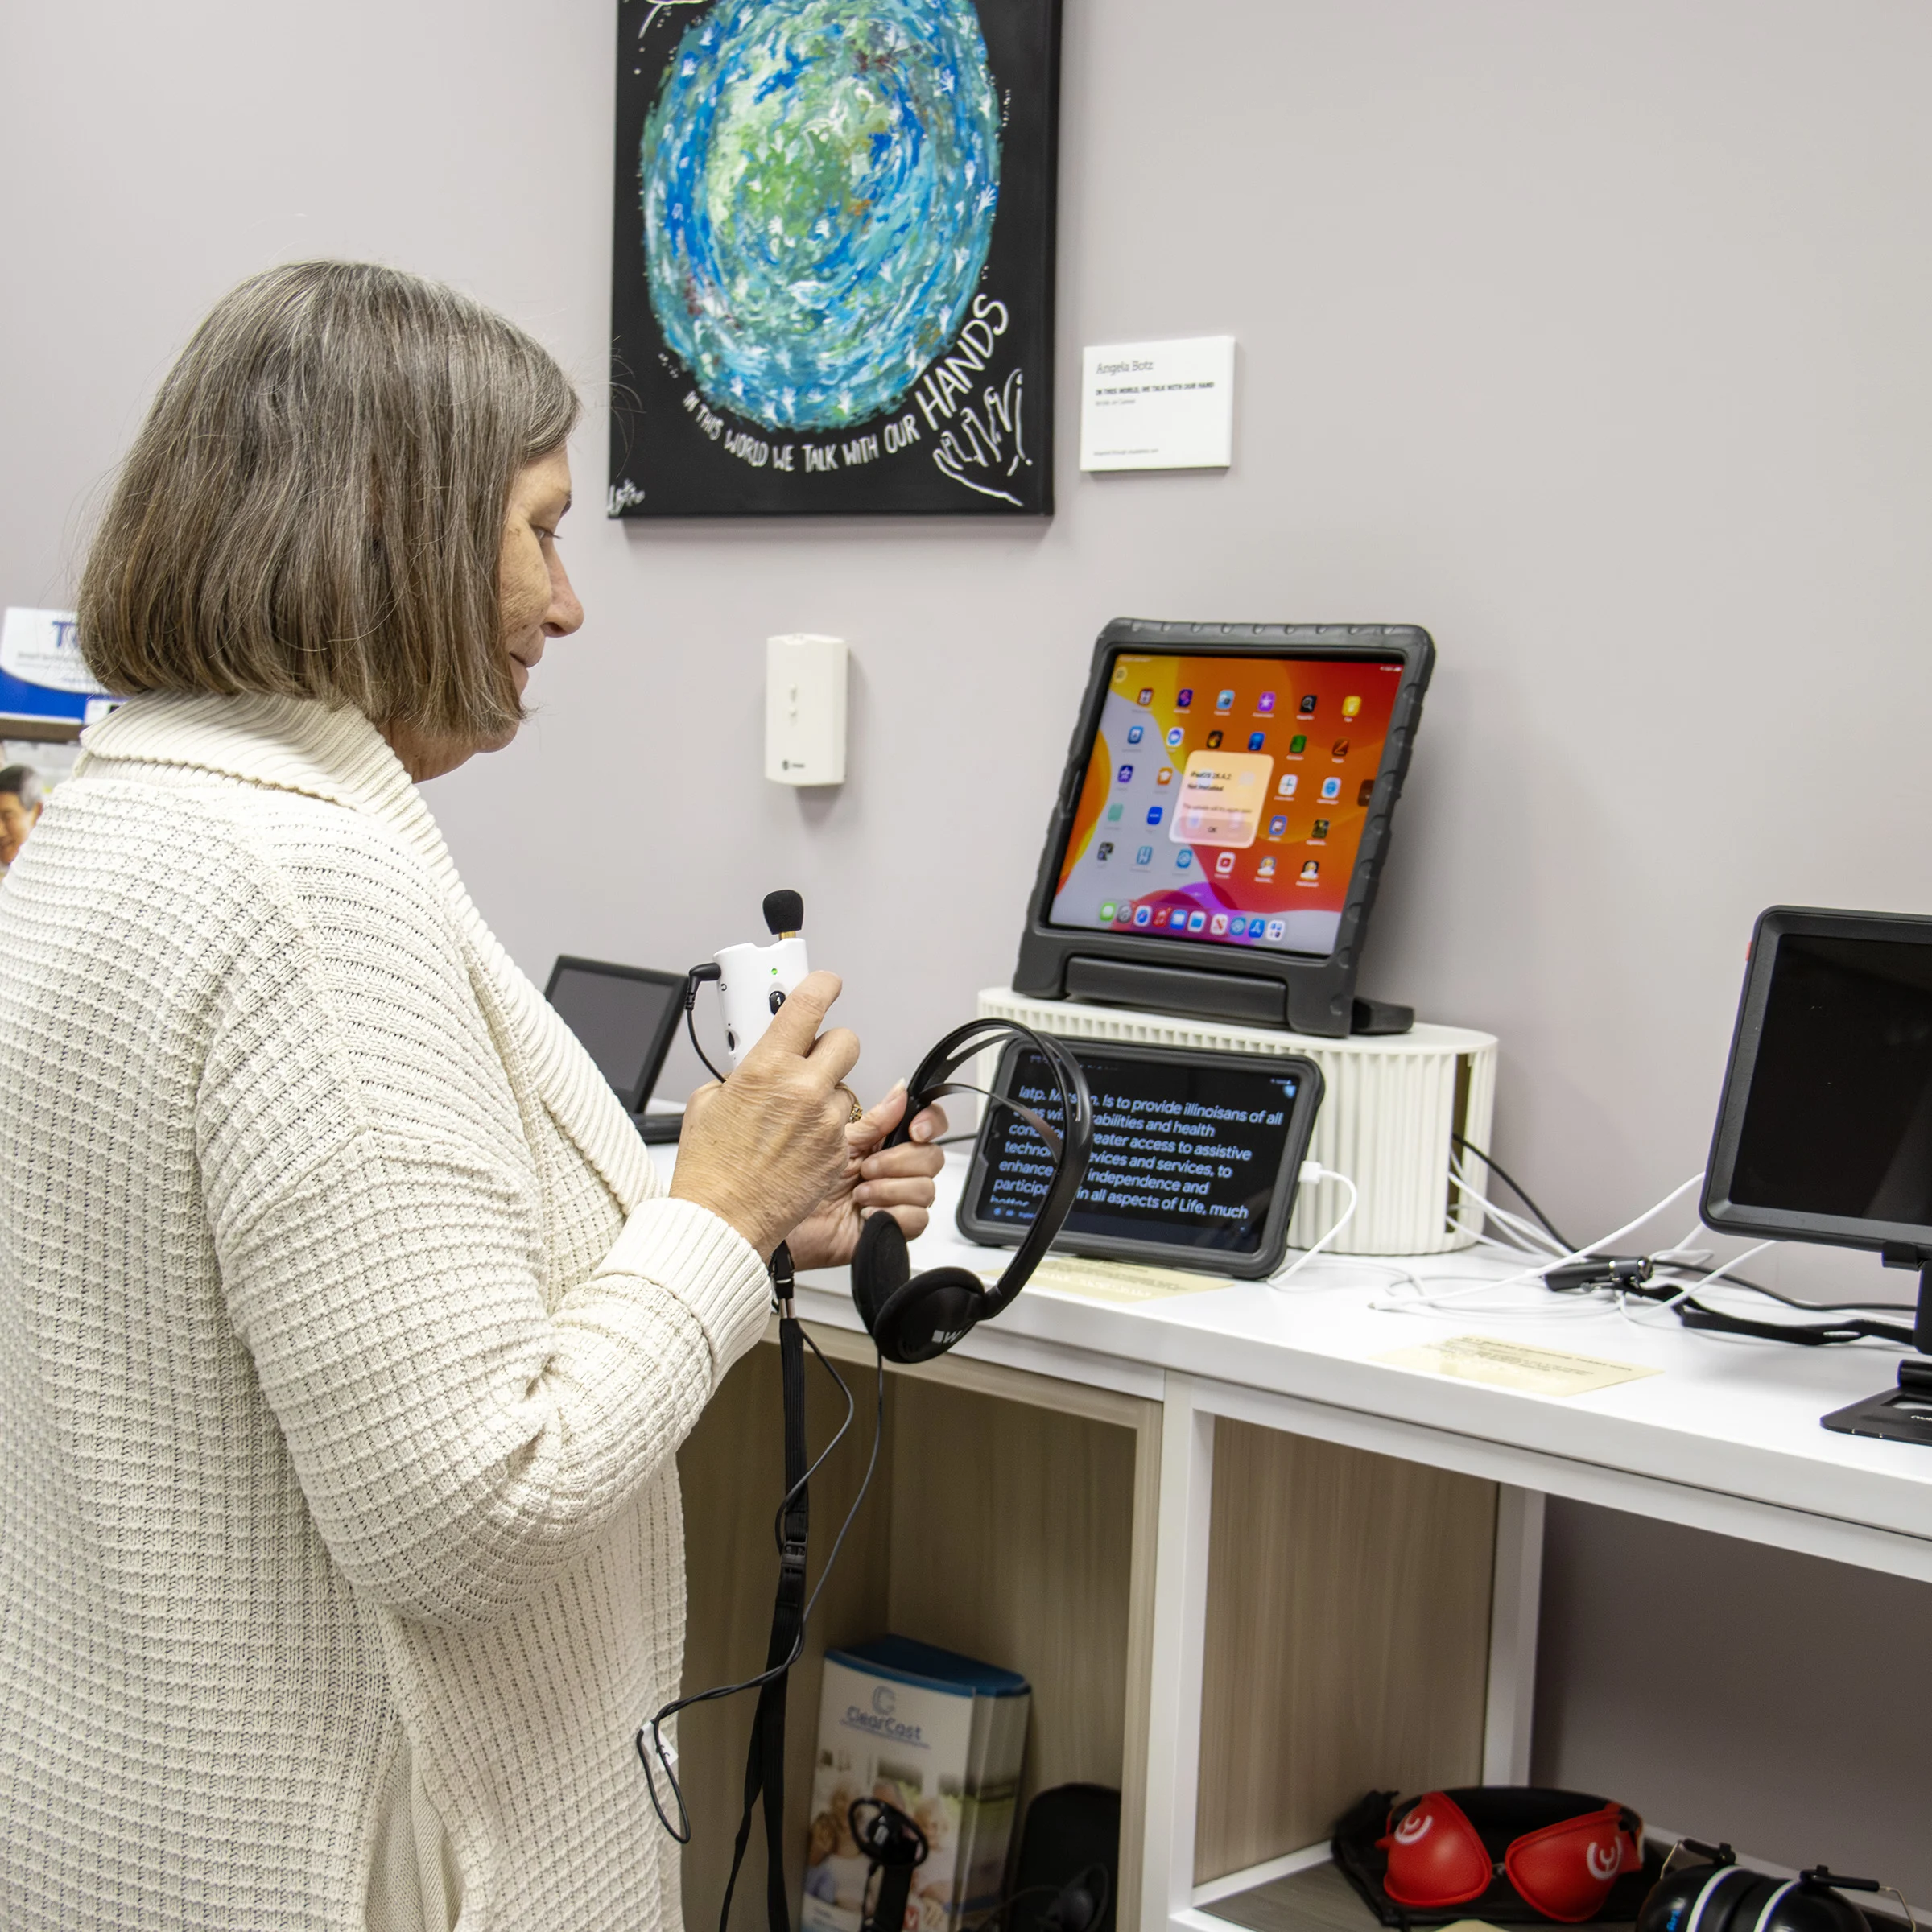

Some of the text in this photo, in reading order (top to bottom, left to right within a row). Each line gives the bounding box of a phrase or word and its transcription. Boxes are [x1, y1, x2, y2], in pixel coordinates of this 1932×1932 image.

[696, 403, 724, 440] THIS
[724, 429, 769, 467] WORLD
[772, 444, 795, 472] WE
[801, 444, 839, 473] TALK
[841, 434, 879, 466] WITH
[884, 414, 921, 453] OUR
[914, 293, 1009, 431] HANDS
[1096, 361, 1153, 376] Angela Botz
[1117, 1096, 1131, 1109] to
[1131, 1100, 1183, 1115] provide
[1249, 1110, 1267, 1124] of
[1266, 1111, 1284, 1125] all
[1146, 1119, 1173, 1133] and
[1173, 1120, 1216, 1137] health
[1130, 1137, 1176, 1152] access
[1178, 1141, 1193, 1154] to
[1194, 1144, 1253, 1161] assistive
[999, 1159, 1211, 1195] enhance independence and
[1089, 1150, 1127, 1166] evices
[1129, 1156, 1156, 1170] and
[1217, 1164, 1233, 1178] to
[1076, 1186, 1089, 1199] in
[1091, 1188, 1108, 1202] all
[1108, 1192, 1160, 1208] aspects
[1162, 1197, 1179, 1210] of
[1209, 1204, 1249, 1220] much
[847, 1705, 921, 1740] ClearCast
